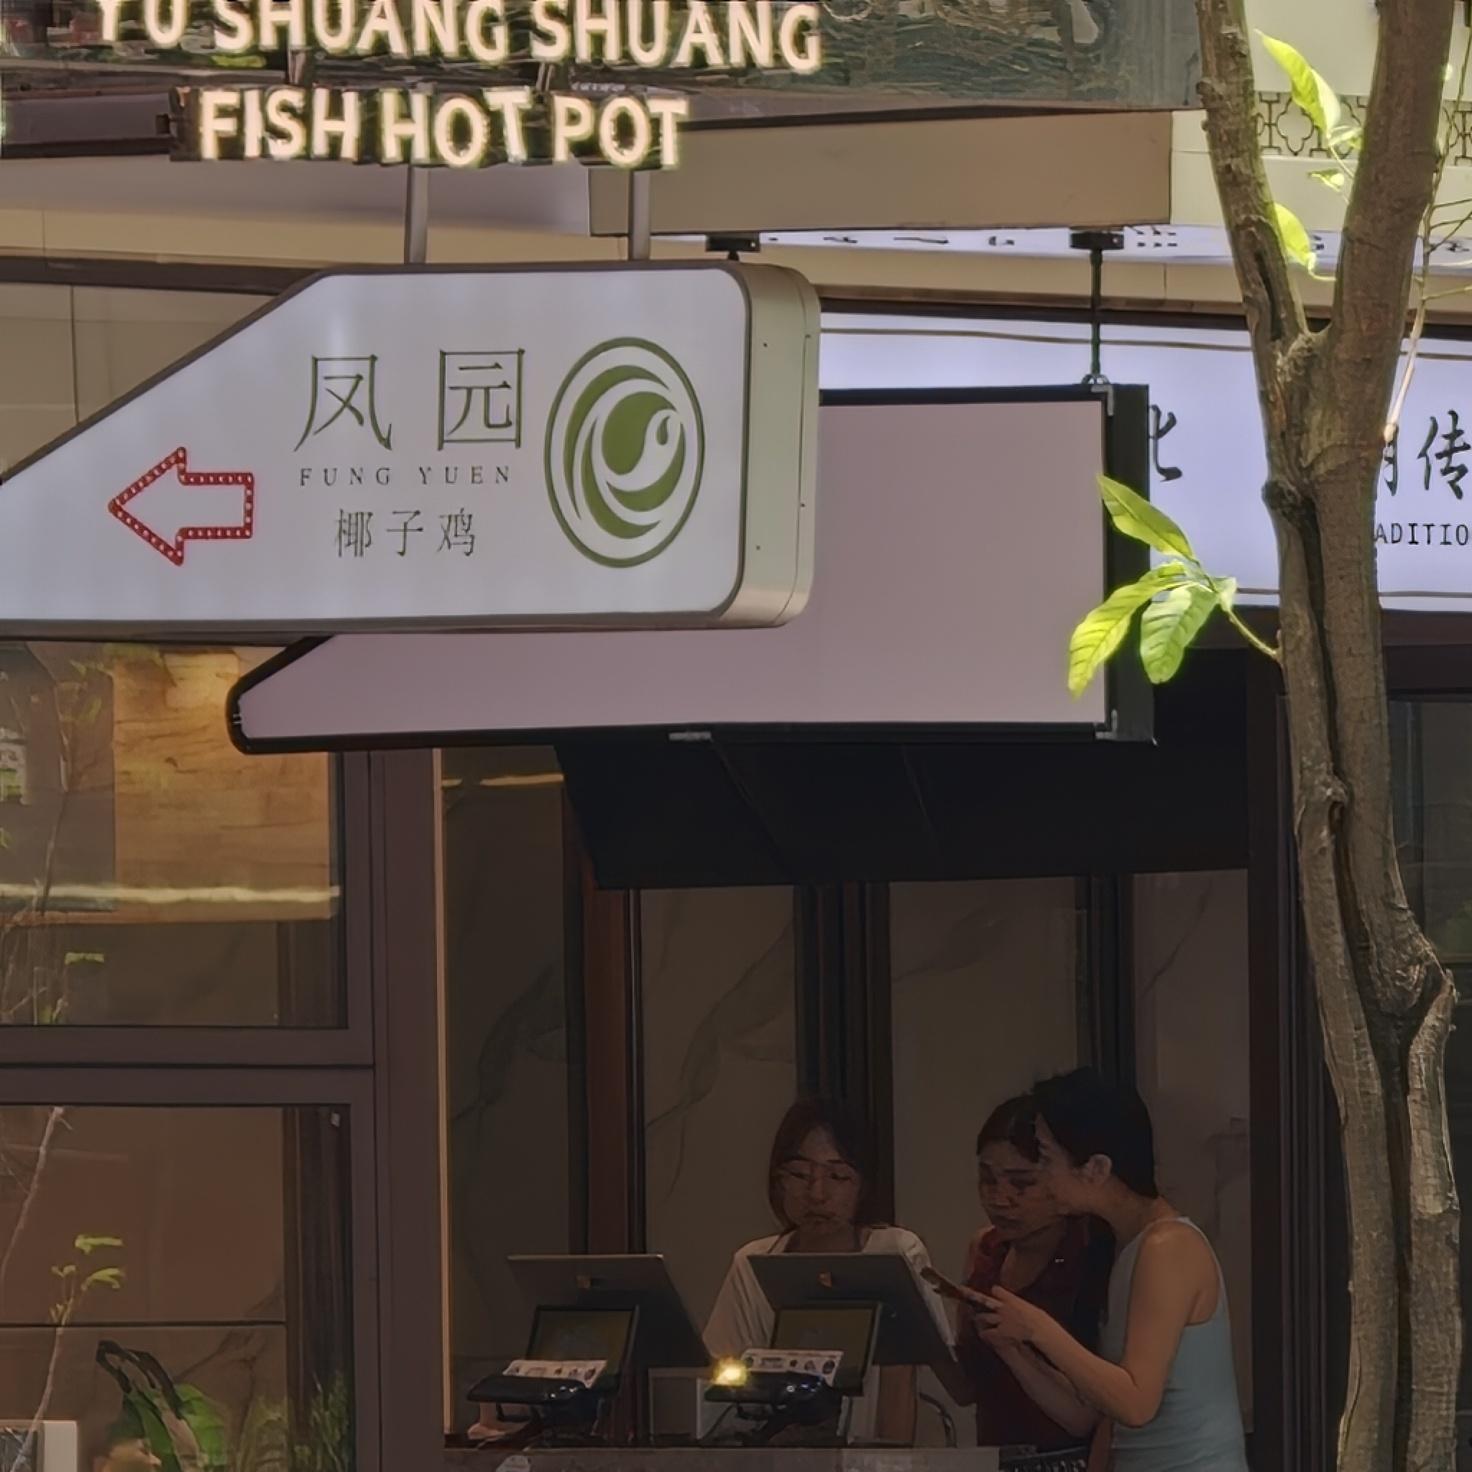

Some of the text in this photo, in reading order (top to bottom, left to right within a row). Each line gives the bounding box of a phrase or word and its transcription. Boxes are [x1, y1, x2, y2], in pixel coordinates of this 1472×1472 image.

[213, 0, 508, 63] SHUANG
[530, 0, 823, 72] SHUANG
[201, 88, 689, 168] FISH HOT POT
[294, 348, 526, 453] 凤园
[300, 466, 513, 487] FUNG YUEN
[334, 507, 477, 560] 椰子鸡
